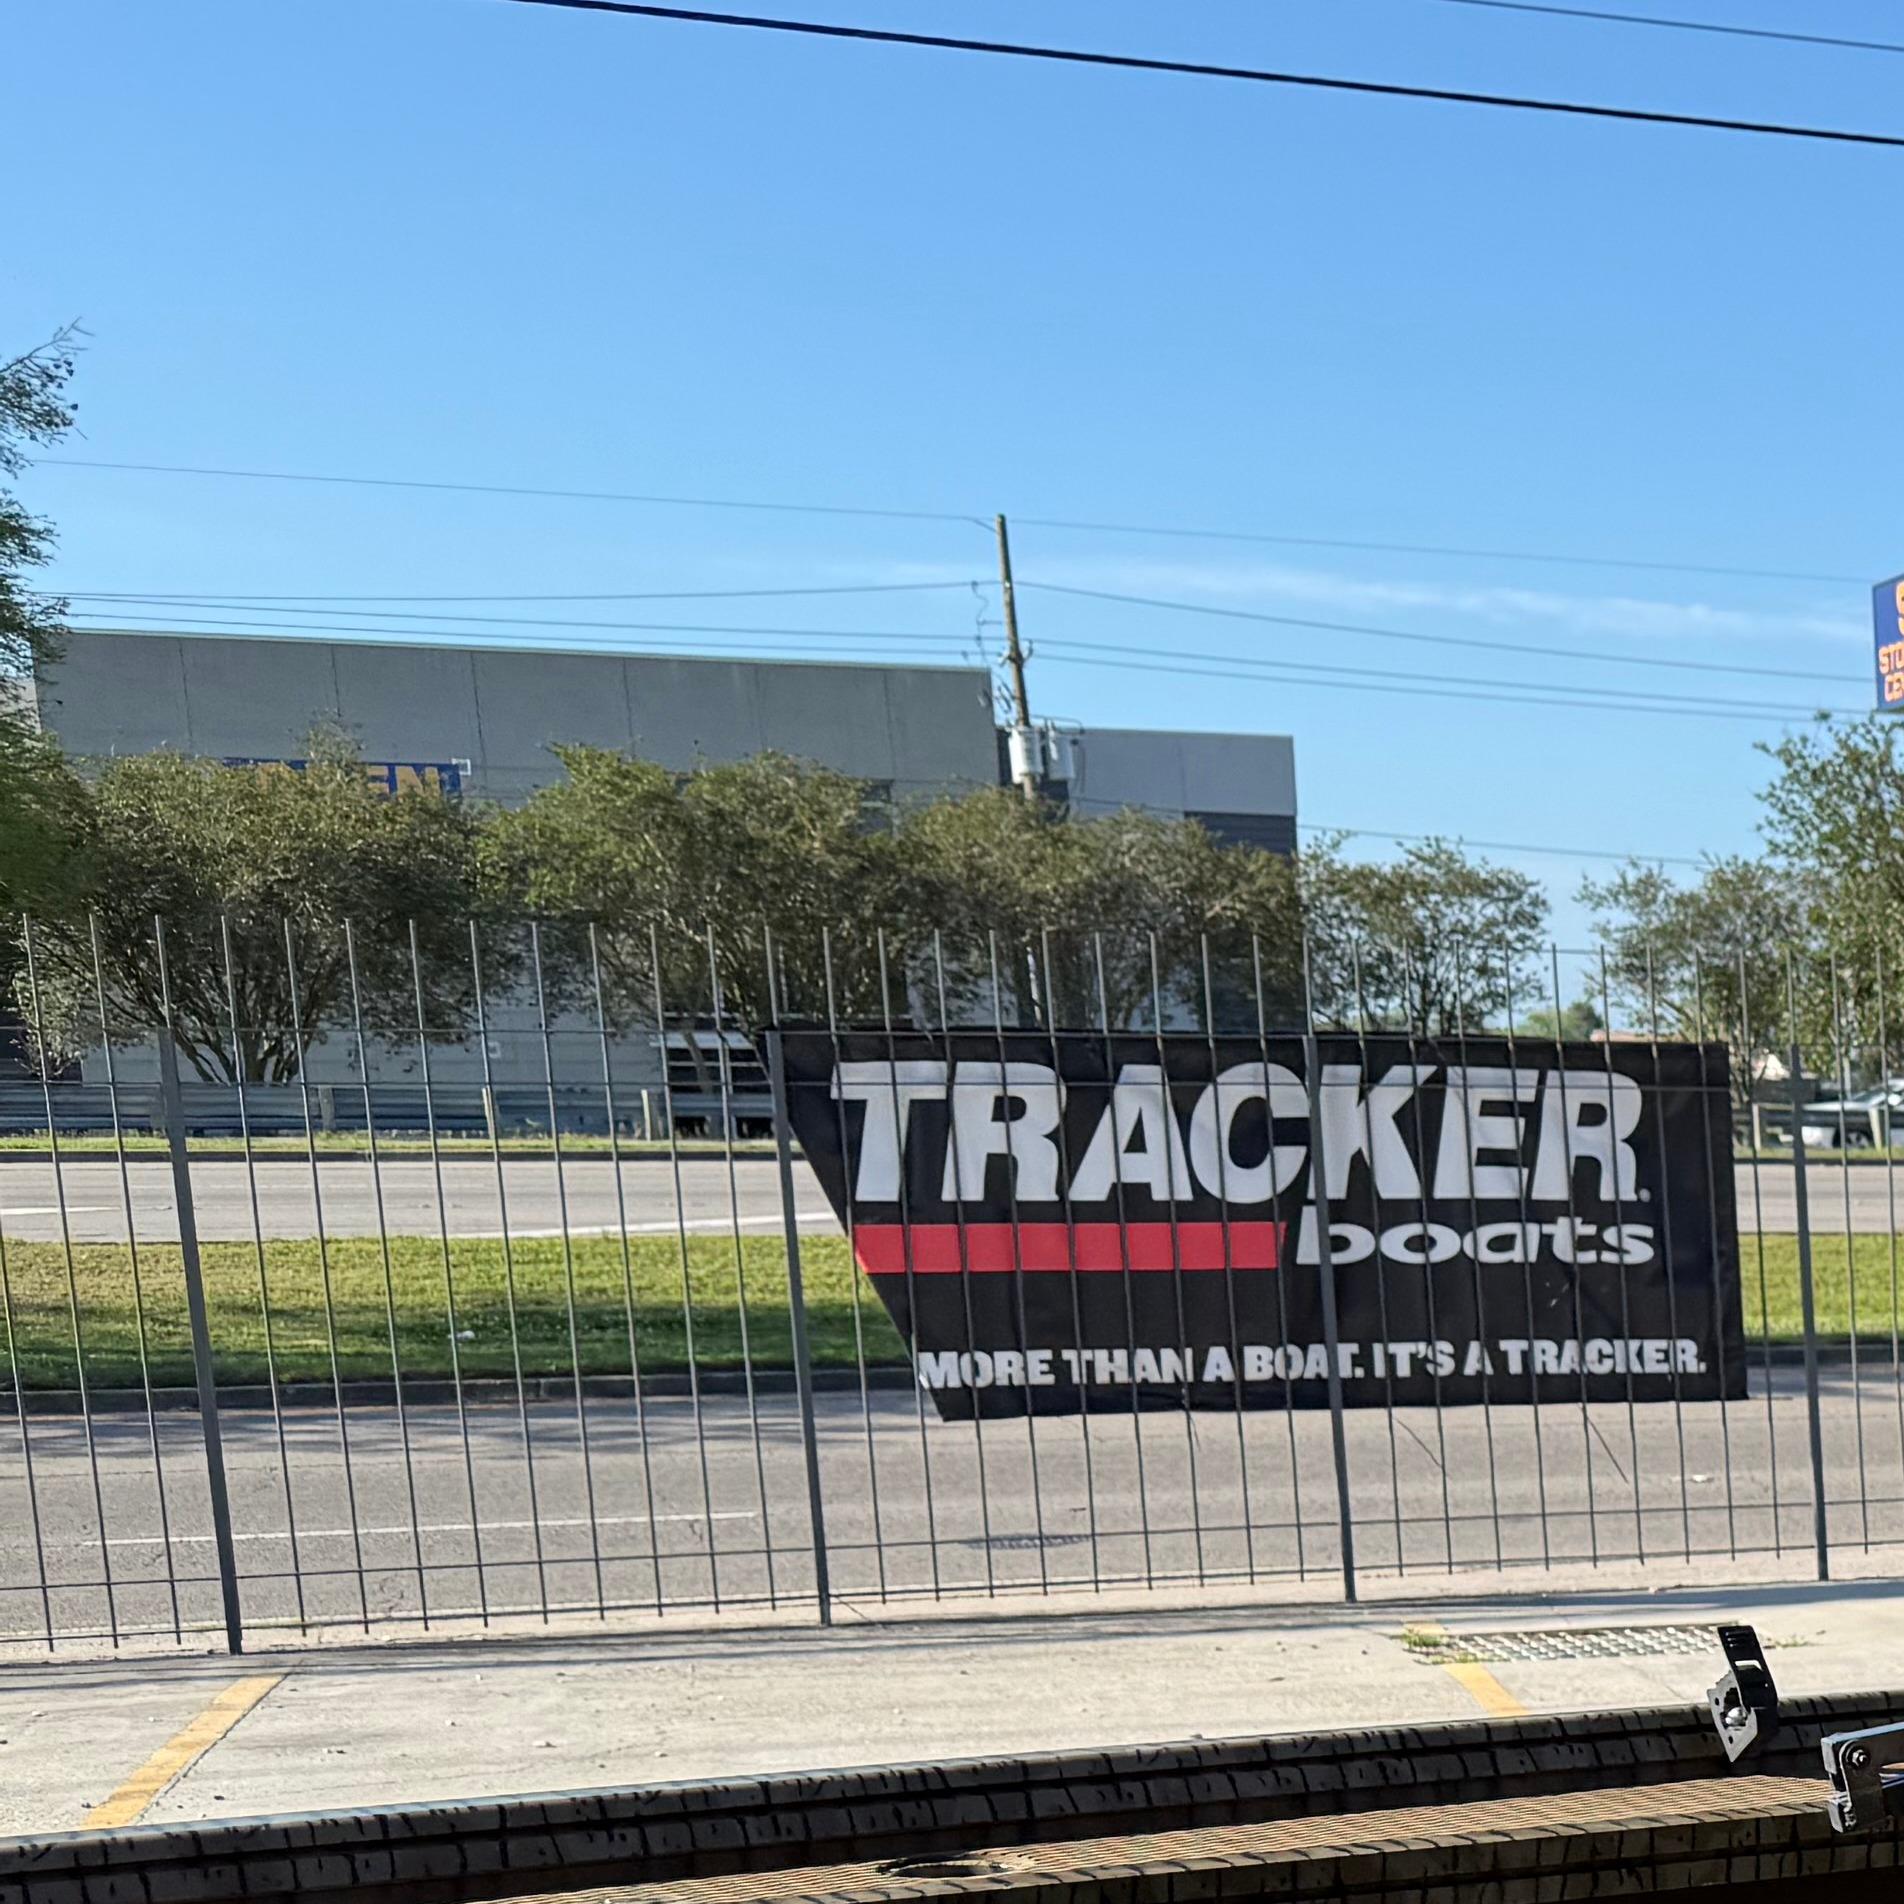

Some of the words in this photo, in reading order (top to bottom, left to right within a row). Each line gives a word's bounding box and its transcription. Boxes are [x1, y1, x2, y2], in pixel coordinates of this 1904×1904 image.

[1296, 1205, 1655, 1265] boats
[918, 1350, 1056, 1389] MORE
[1062, 1347, 1194, 1385] THAN
[1202, 1345, 1235, 1382] A
[1463, 1341, 1495, 1376] A
